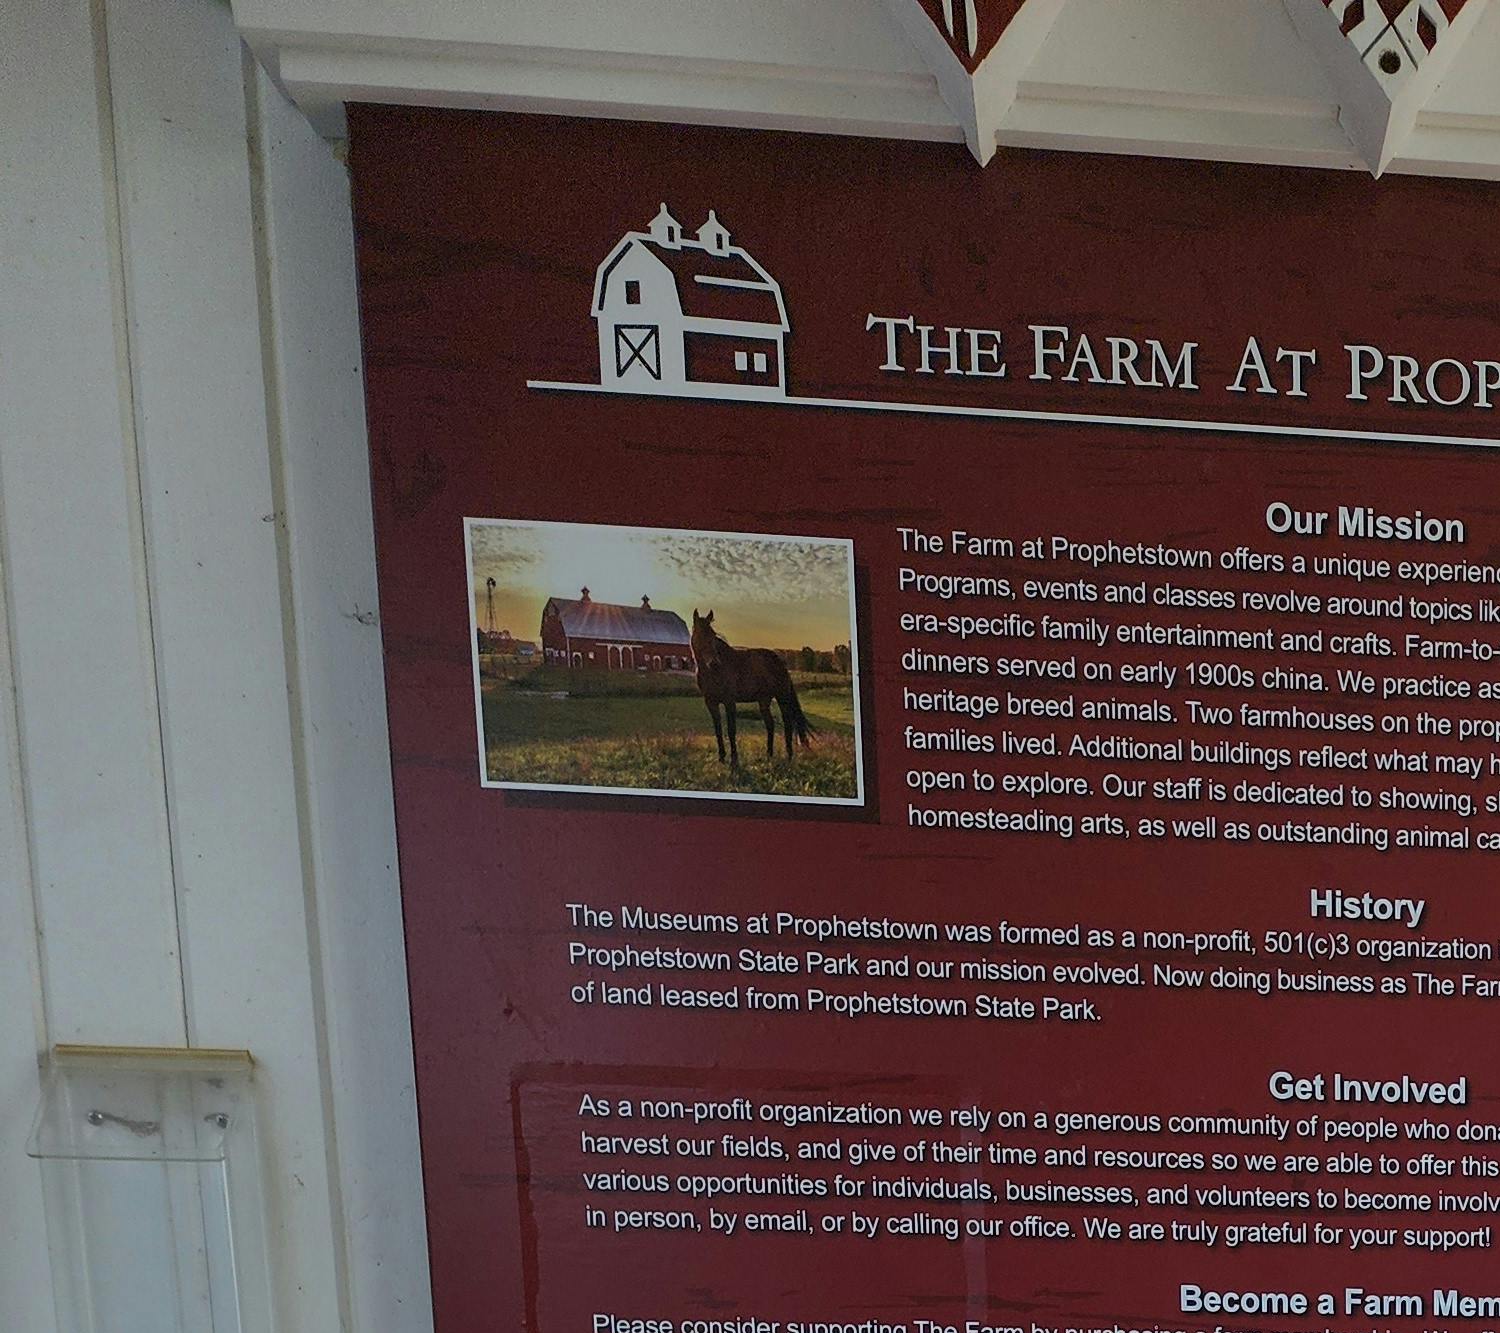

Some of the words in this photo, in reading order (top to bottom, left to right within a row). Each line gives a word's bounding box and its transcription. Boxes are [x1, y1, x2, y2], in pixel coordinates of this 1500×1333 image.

[865, 312, 1006, 377] THE
[1027, 324, 1199, 390] FARM
[1225, 336, 1316, 397] AT
[1265, 501, 1329, 535] Our
[1338, 505, 1464, 543] Mission
[896, 527, 944, 553] The
[951, 530, 1014, 557] Farm
[1021, 536, 1045, 560] at
[1051, 536, 1212, 569] Prophetstown
[1219, 546, 1285, 572] offers
[1291, 555, 1306, 574] a
[1313, 552, 1391, 582] unique
[908, 803, 1073, 838] homesteading
[1080, 812, 1130, 839] arts,
[1137, 818, 1166, 837] as
[1171, 816, 1216, 839] well
[1223, 822, 1251, 840] as
[1257, 820, 1388, 851] outstanding
[1395, 824, 1469, 849] animal
[1310, 888, 1426, 928] History
[565, 903, 614, 928] The
[621, 905, 739, 933] Museums
[746, 912, 770, 934] at
[776, 912, 938, 942] Prophetstown
[944, 924, 992, 943] was
[998, 920, 1080, 946] formed
[1087, 929, 1115, 947] as
[1121, 930, 1136, 948] a
[1143, 929, 1256, 956] non-profit,
[1263, 930, 1350, 961] 501(c)3
[1356, 935, 1492, 962] organization
[571, 980, 595, 1003] of
[601, 981, 652, 1005] land
[660, 983, 739, 1009] leased
[745, 986, 800, 1011] from
[807, 988, 967, 1018] Prophetstown
[974, 994, 1035, 1019] State
[1042, 997, 1102, 1021] Park.
[1269, 1071, 1325, 1101] Get
[1334, 1073, 1466, 1105] Involved
[585, 1204, 606, 1227] in
[614, 1210, 702, 1233] person,
[709, 1207, 738, 1235] by
[744, 1209, 814, 1235] email,
[821, 1215, 846, 1232] or
[851, 1211, 880, 1238] by
[886, 1212, 959, 1240] calling
[965, 1219, 1004, 1236] our
[1009, 1215, 1076, 1238] office.
[1082, 1216, 1122, 1239] We
[1128, 1223, 1165, 1240] are
[1170, 1219, 1219, 1247] truly
[1225, 1221, 1307, 1247] grateful
[1313, 1222, 1344, 1244] for
[1348, 1228, 1398, 1250] your
[1403, 1226, 1491, 1252] support!
[1180, 1284, 1308, 1315] Become
[1317, 1293, 1335, 1315] a
[1345, 1287, 1423, 1316] Farm
